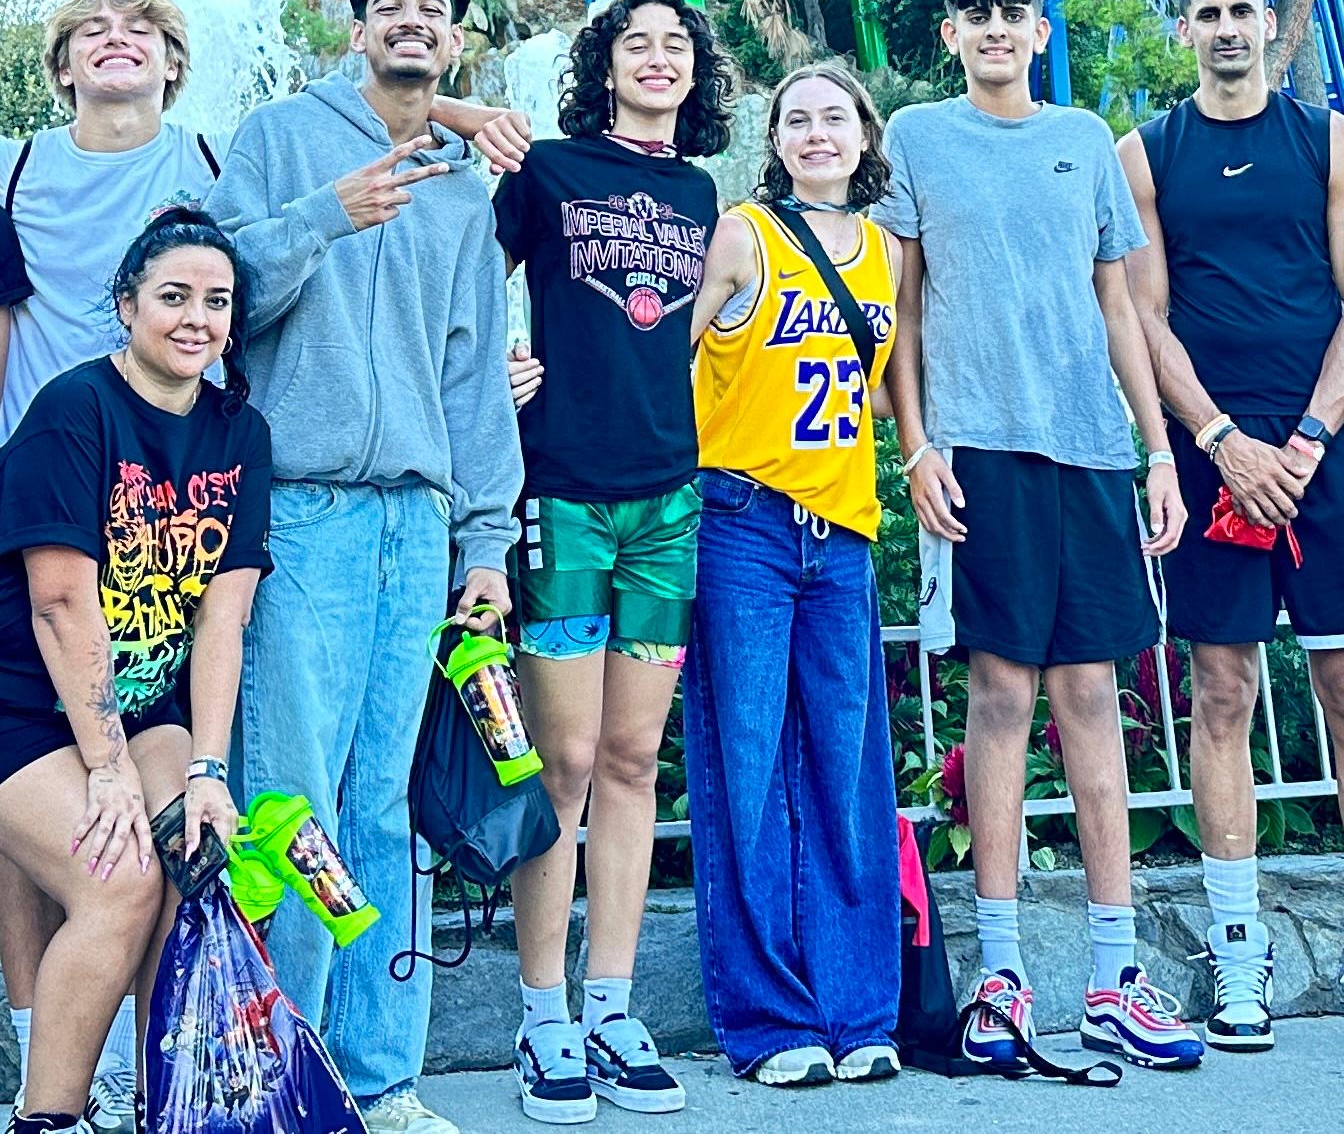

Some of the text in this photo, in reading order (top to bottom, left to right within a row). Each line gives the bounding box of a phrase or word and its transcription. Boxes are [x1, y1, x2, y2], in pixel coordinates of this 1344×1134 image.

[561, 202, 653, 242] IMPERIAL
[571, 239, 704, 294] INVITATIONA
[625, 271, 668, 294] GIRLS
[792, 357, 865, 450] 23
